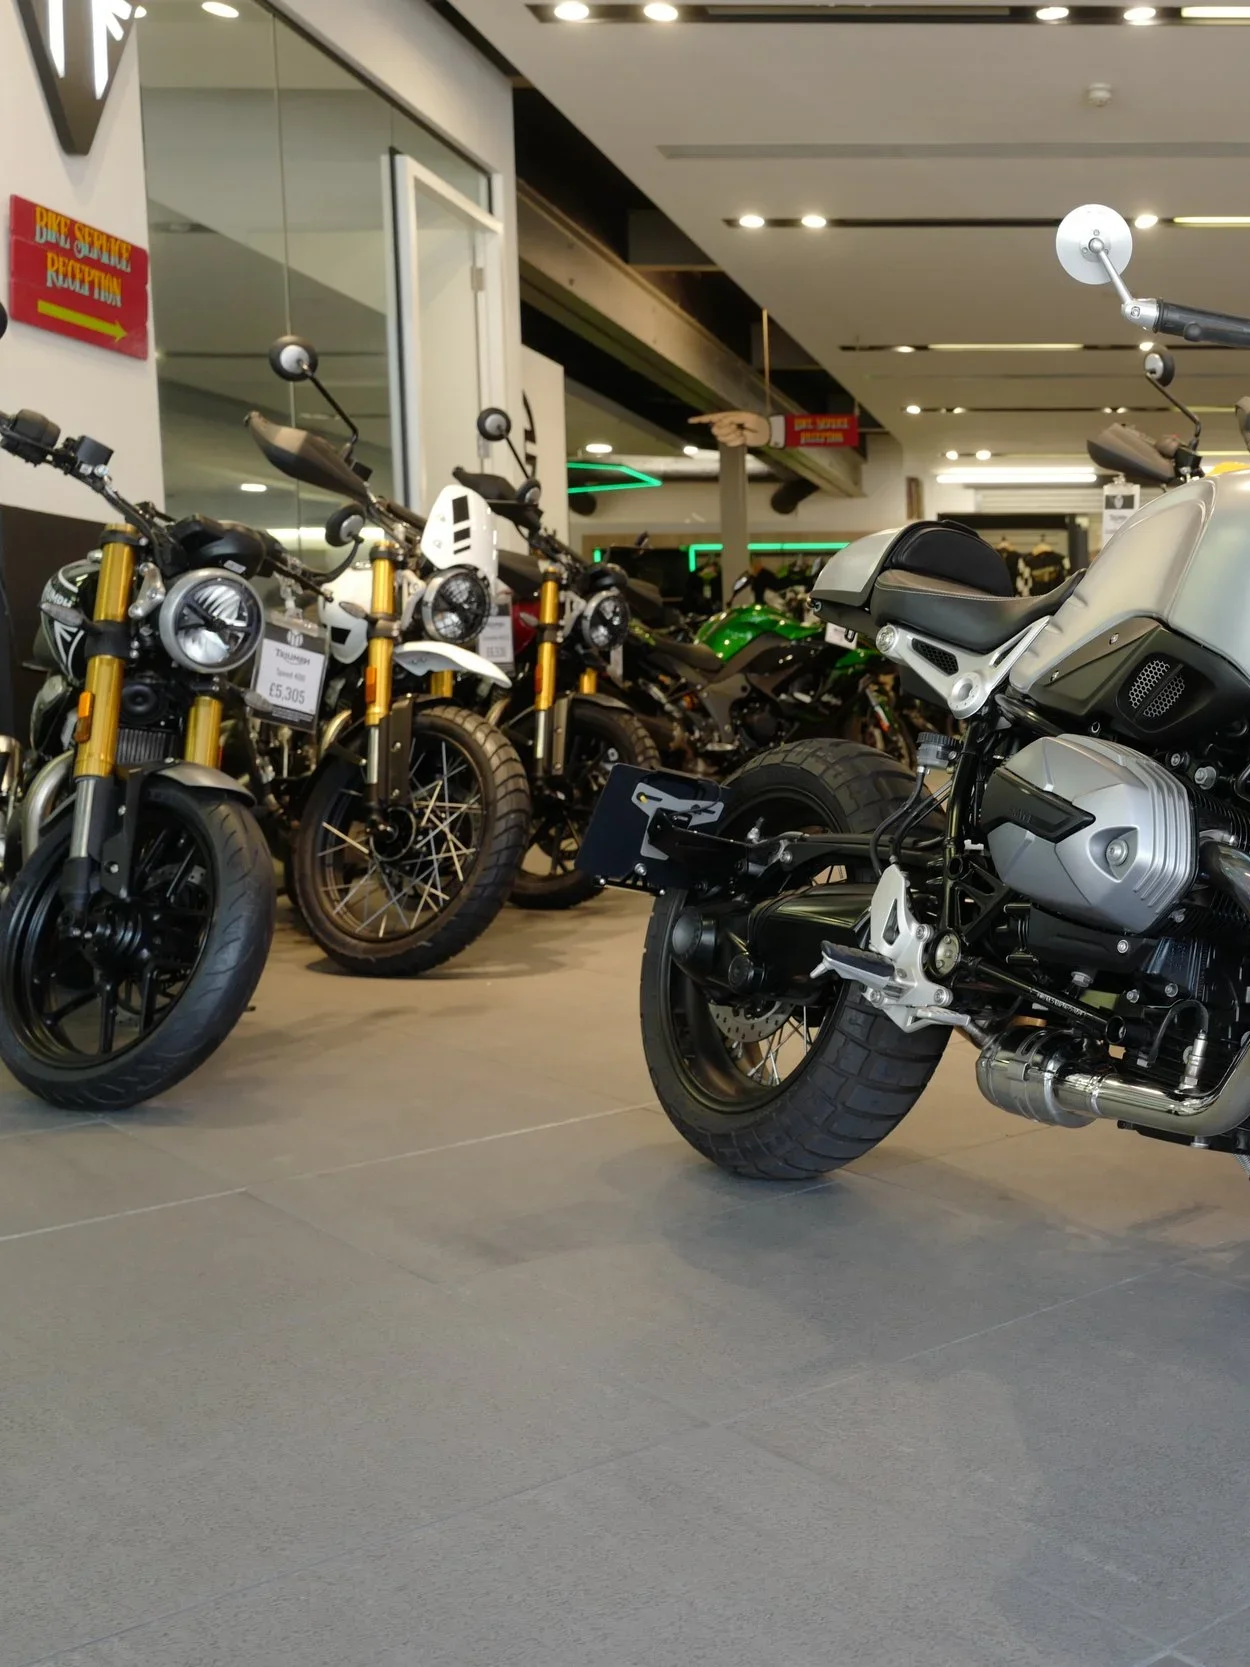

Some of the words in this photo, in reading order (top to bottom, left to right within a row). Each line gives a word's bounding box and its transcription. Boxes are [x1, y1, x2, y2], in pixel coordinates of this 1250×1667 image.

[35, 206, 71, 249] BIKE
[74, 221, 132, 272] SERVICE
[46, 251, 122, 308] RECEPTION
[275, 648, 311, 666] TRIUMPH
[269, 682, 306, 705] £5,305
